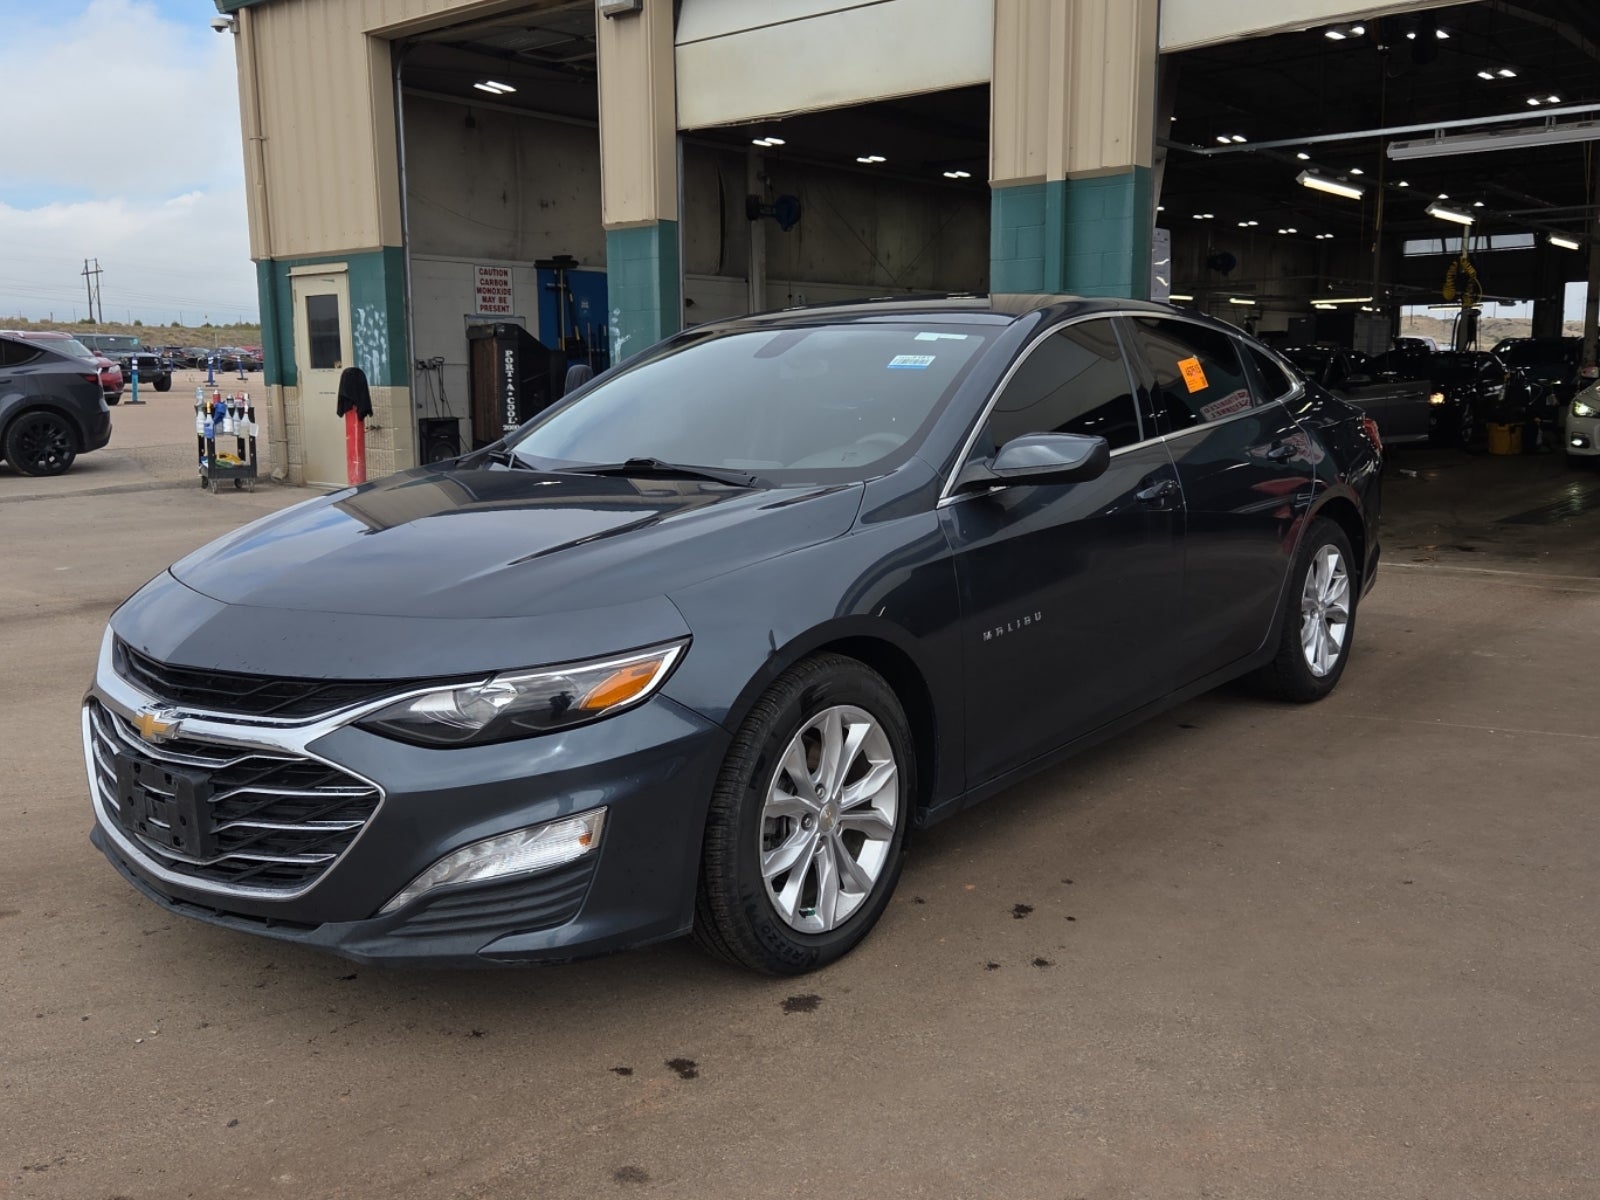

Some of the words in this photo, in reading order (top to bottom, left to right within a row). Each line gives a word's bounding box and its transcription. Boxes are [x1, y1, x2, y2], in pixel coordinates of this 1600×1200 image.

[479, 268, 508, 277] CAUTION
[480, 278, 508, 287] CARBON
[476, 287, 512, 295] MONOXIDE
[482, 295, 496, 304] MAY
[498, 296, 507, 304] BE
[480, 304, 510, 313] PRESENT
[982, 611, 1042, 641] MALIBU
